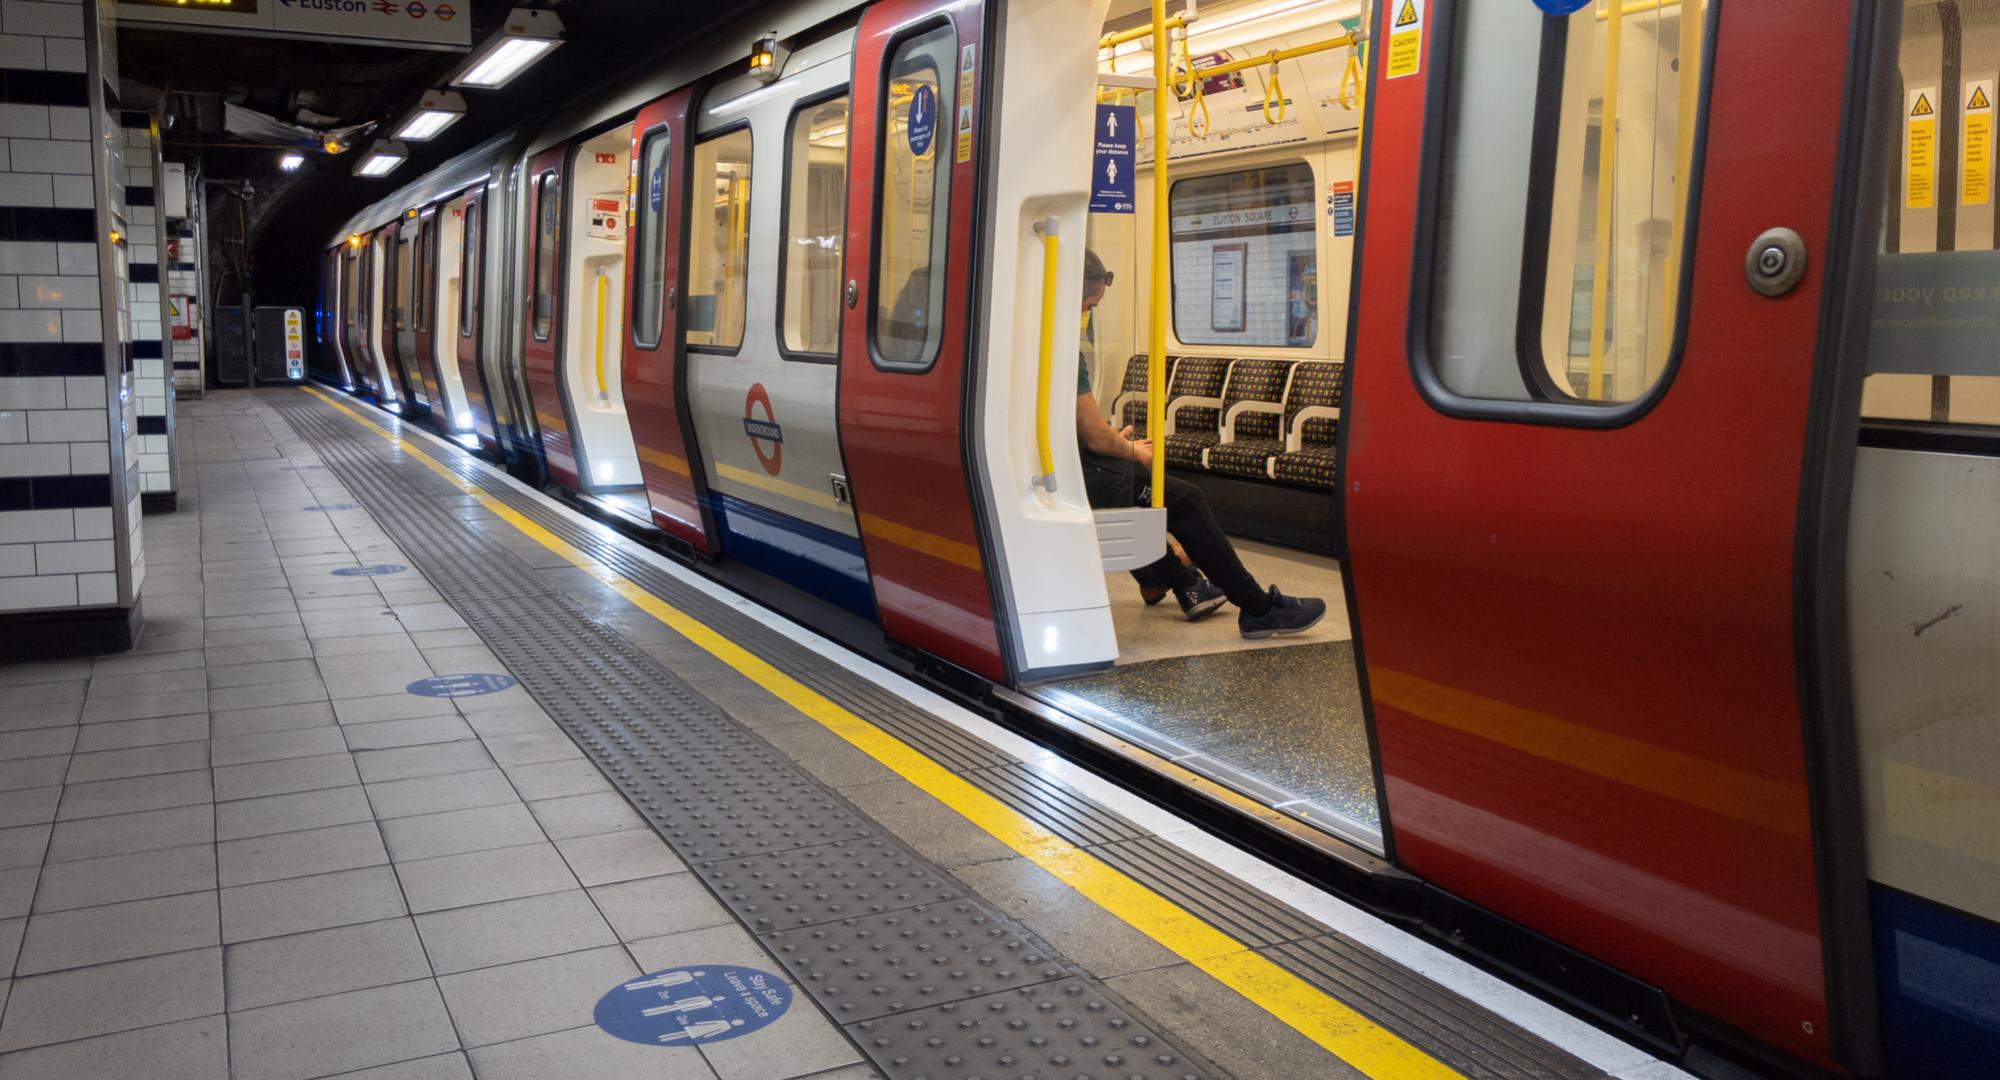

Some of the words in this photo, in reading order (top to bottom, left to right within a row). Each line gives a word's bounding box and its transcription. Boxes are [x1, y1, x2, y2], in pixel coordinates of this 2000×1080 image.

[300, 0, 366, 13] Euston
[1213, 212, 1241, 226] EUSTON
[1245, 209, 1272, 223] SQUARE
[746, 422, 780, 438] UNDERGROUND
[657, 990, 670, 1000] 2m
[723, 971, 746, 992] Leave
[744, 996, 769, 1018] space
[748, 974, 768, 991] Stay
[762, 988, 782, 1006] Safe
[676, 1013, 689, 1026] 2m
[1801, 1020, 1814, 1034] G
